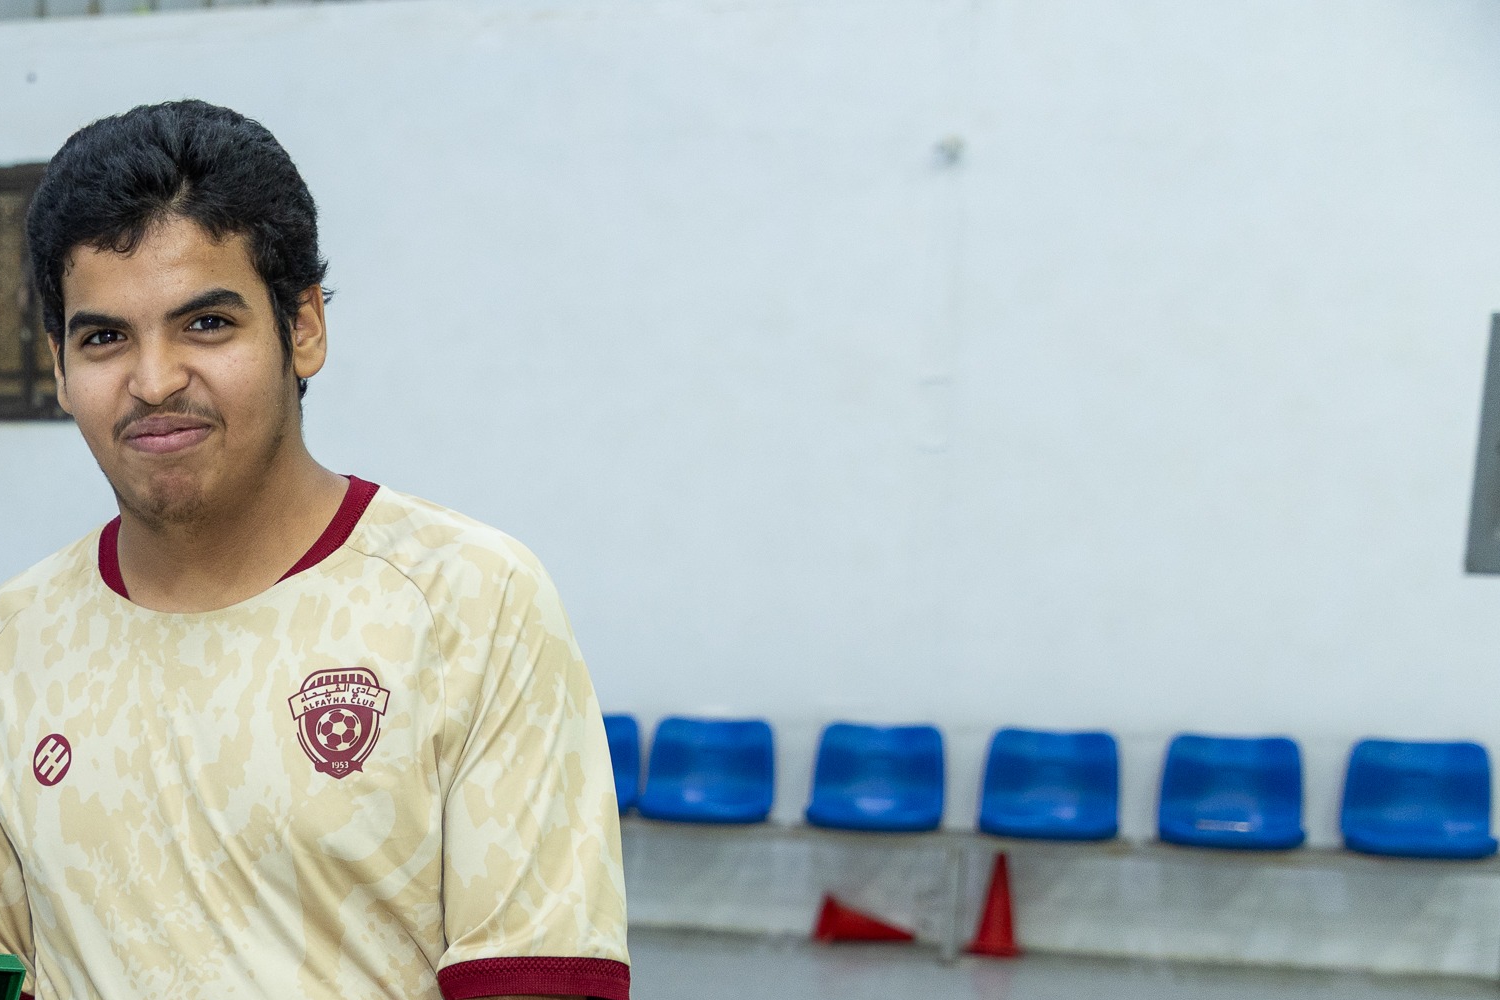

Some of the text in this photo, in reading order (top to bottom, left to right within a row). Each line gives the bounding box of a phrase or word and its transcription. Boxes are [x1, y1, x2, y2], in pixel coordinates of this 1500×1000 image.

[300, 683, 381, 703] نادي الفيحاء
[303, 696, 376, 712] ALFAYHA CLUB
[331, 761, 349, 769] 1953
